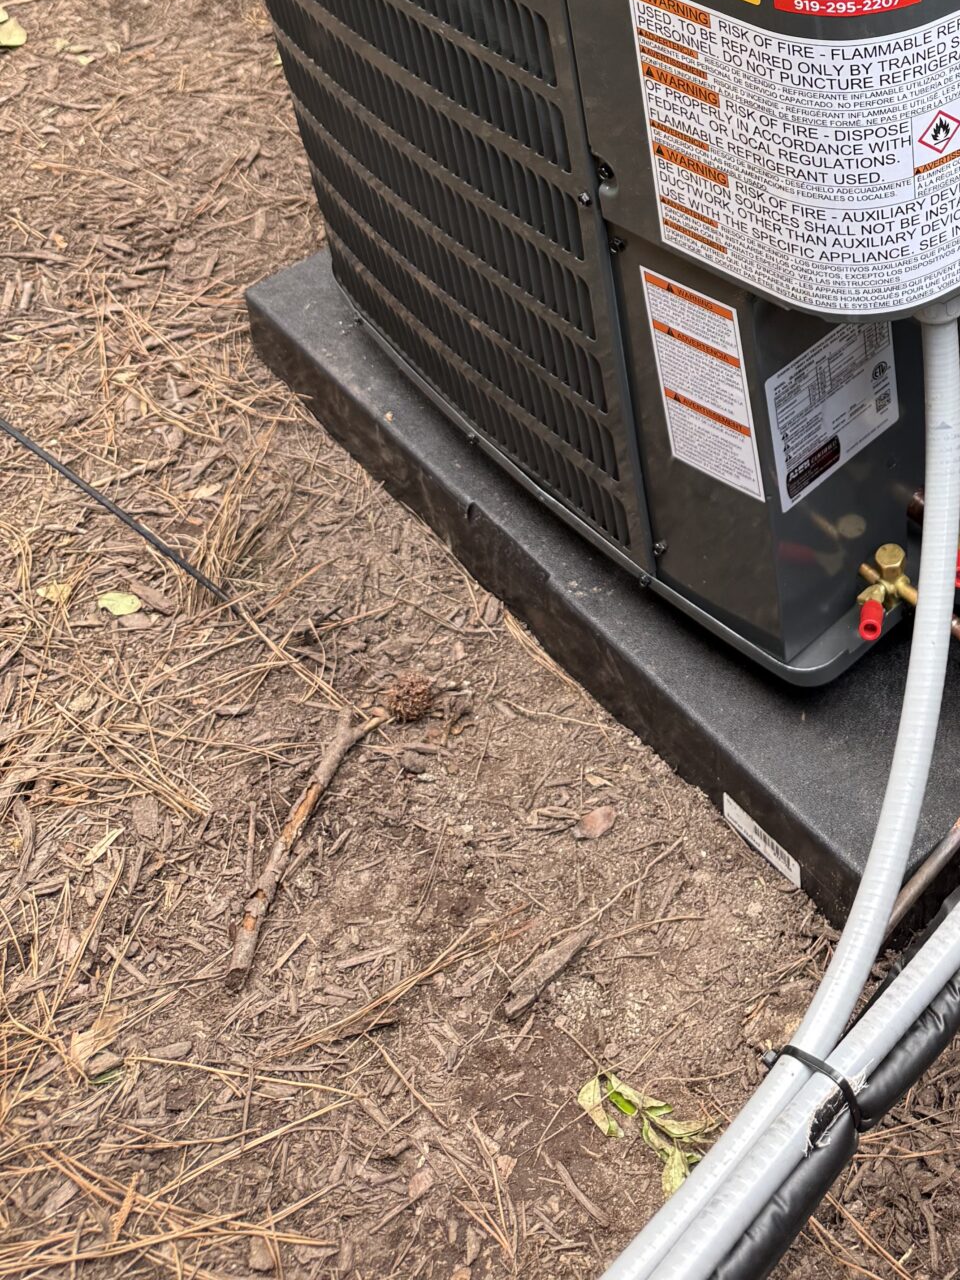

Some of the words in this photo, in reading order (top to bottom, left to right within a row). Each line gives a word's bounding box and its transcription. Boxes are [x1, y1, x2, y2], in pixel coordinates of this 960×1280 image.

[636, 2, 675, 27] USED.
[678, 19, 697, 35] TO
[700, 28, 718, 45] BE
[721, 38, 792, 72] REPAIRED
[798, 62, 846, 77] ONLY
[850, 62, 872, 76] BY
[878, 43, 948, 72] TRAINED
[638, 16, 720, 59] PERSONNEL.
[723, 50, 743, 68] DO
[746, 59, 776, 80] NOT
[780, 71, 874, 90] PUNCTURE
[643, 31, 696, 58] ADVERTENCIA
[646, 48, 708, 78] AVERTISSEMENT
[718, 20, 750, 43] RISK
[754, 34, 772, 50] OF
[778, 42, 814, 59] FIRE
[831, 31, 933, 60] FLAMMABLE
[645, 79, 662, 95] OF
[664, 87, 733, 123] PROPERLY
[737, 115, 750, 133] IN
[752, 127, 867, 156] ACCORDANCE
[869, 135, 912, 154] WITH
[648, 94, 704, 127] FEDERAL
[709, 119, 729, 139] OR
[732, 132, 775, 156] LOCAL
[778, 148, 900, 170] REGULATIONS.
[656, 69, 719, 105] WARNING
[725, 100, 756, 122] RISK
[759, 114, 778, 130] OF
[783, 122, 819, 139] FIRE
[834, 122, 910, 141] DISPOSE
[656, 124, 705, 150] ADVERTENCIA
[650, 108, 725, 149] FLAMMABLE
[728, 143, 828, 183] REFRIGERANT
[834, 172, 885, 185] USED.
[658, 158, 673, 173] BE
[677, 165, 731, 200] IGNITION
[735, 194, 799, 228] SOURCES
[804, 220, 856, 236] SHALL
[861, 222, 895, 235] NOT
[900, 214, 920, 231] BE
[660, 172, 734, 215] DUCTWORK,
[738, 209, 782, 235] OTHER
[786, 228, 827, 247] THAN
[832, 229, 916, 248] AUXILIARY
[667, 150, 727, 184] WARNING
[735, 181, 764, 203] RISK
[768, 196, 786, 210] OF
[792, 204, 826, 221] FIRE
[842, 198, 926, 223] AUXILIARY
[667, 201, 716, 227] ADVERTENCIA
[661, 186, 685, 205] USE
[689, 197, 720, 220] WITH
[724, 214, 748, 232] THE
[752, 225, 814, 258] SPECIFIC
[819, 246, 914, 264] APPLIANCE.
[919, 233, 948, 251] SEE
[668, 223, 726, 253] AVERTISSEMENT
[677, 290, 712, 310] WARNING
